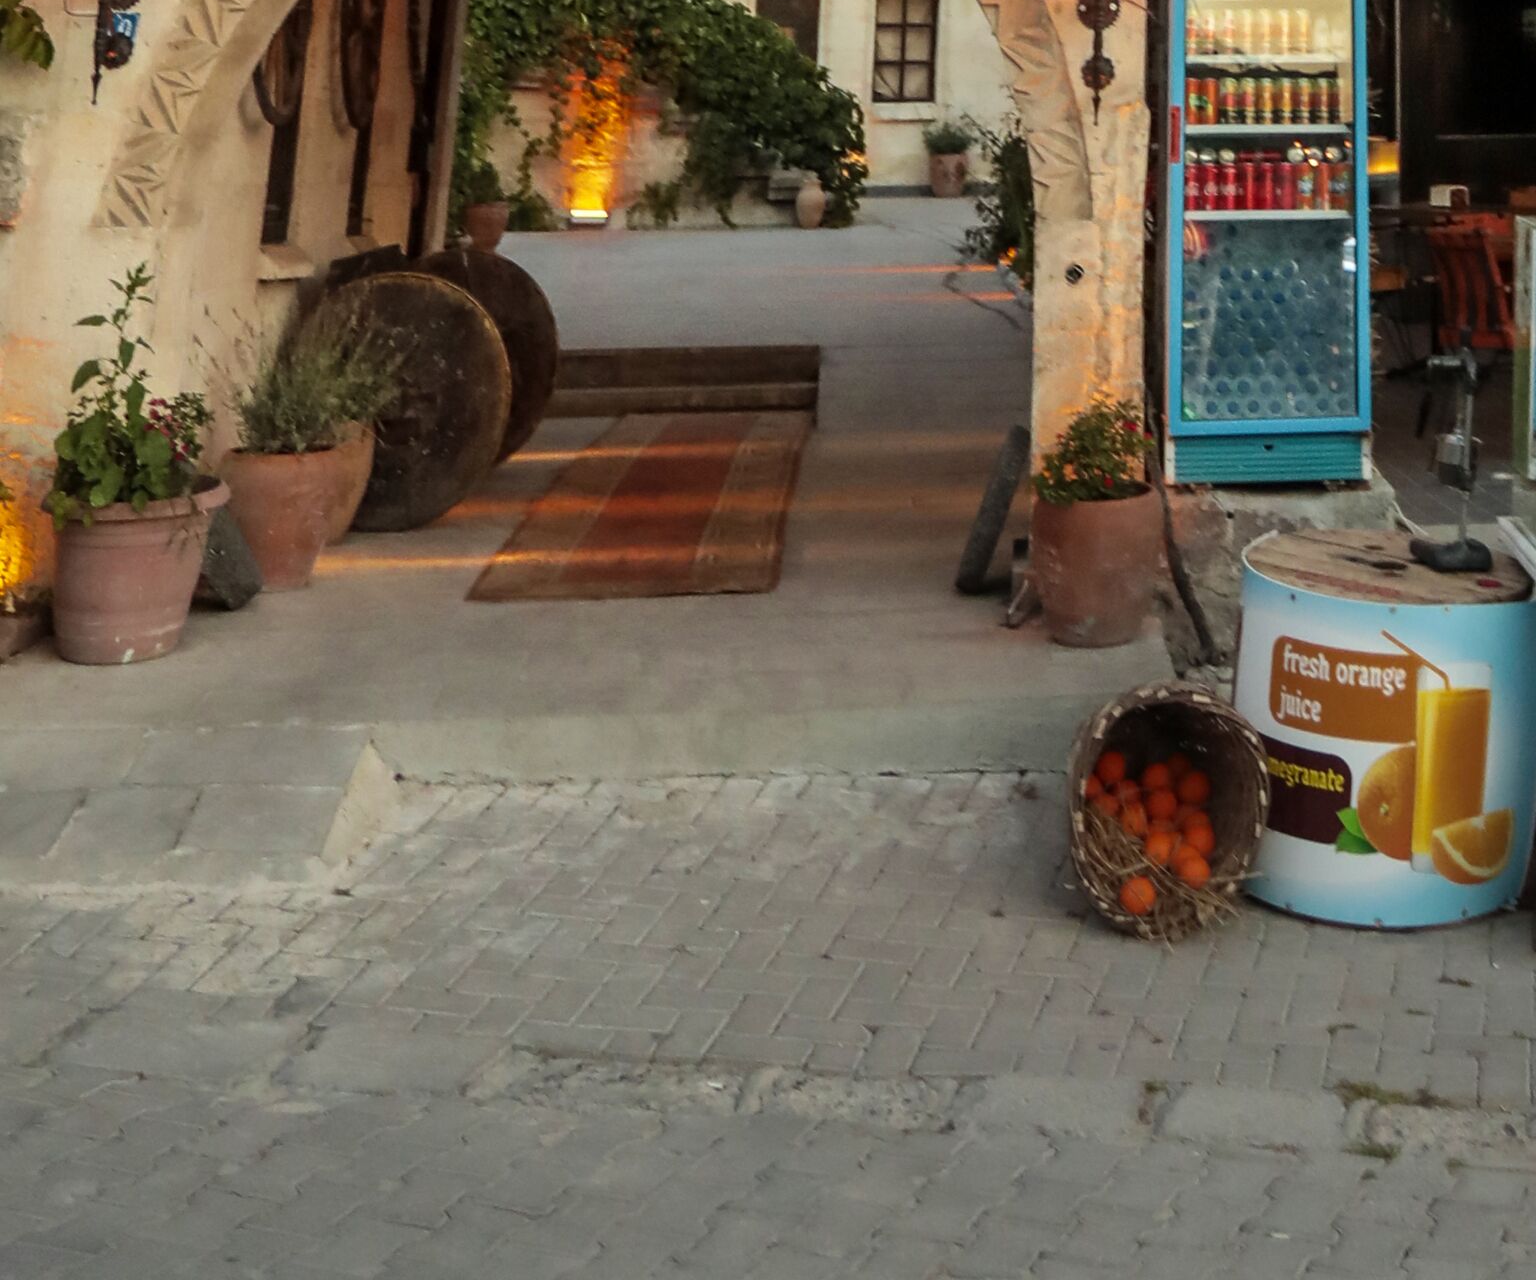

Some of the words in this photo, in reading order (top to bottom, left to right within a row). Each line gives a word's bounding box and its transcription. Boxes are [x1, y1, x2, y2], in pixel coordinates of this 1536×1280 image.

[1283, 643, 1331, 681] fresh
[1335, 662, 1408, 696] orange
[1277, 685, 1322, 722] juice
[1267, 756, 1345, 793] megranate
